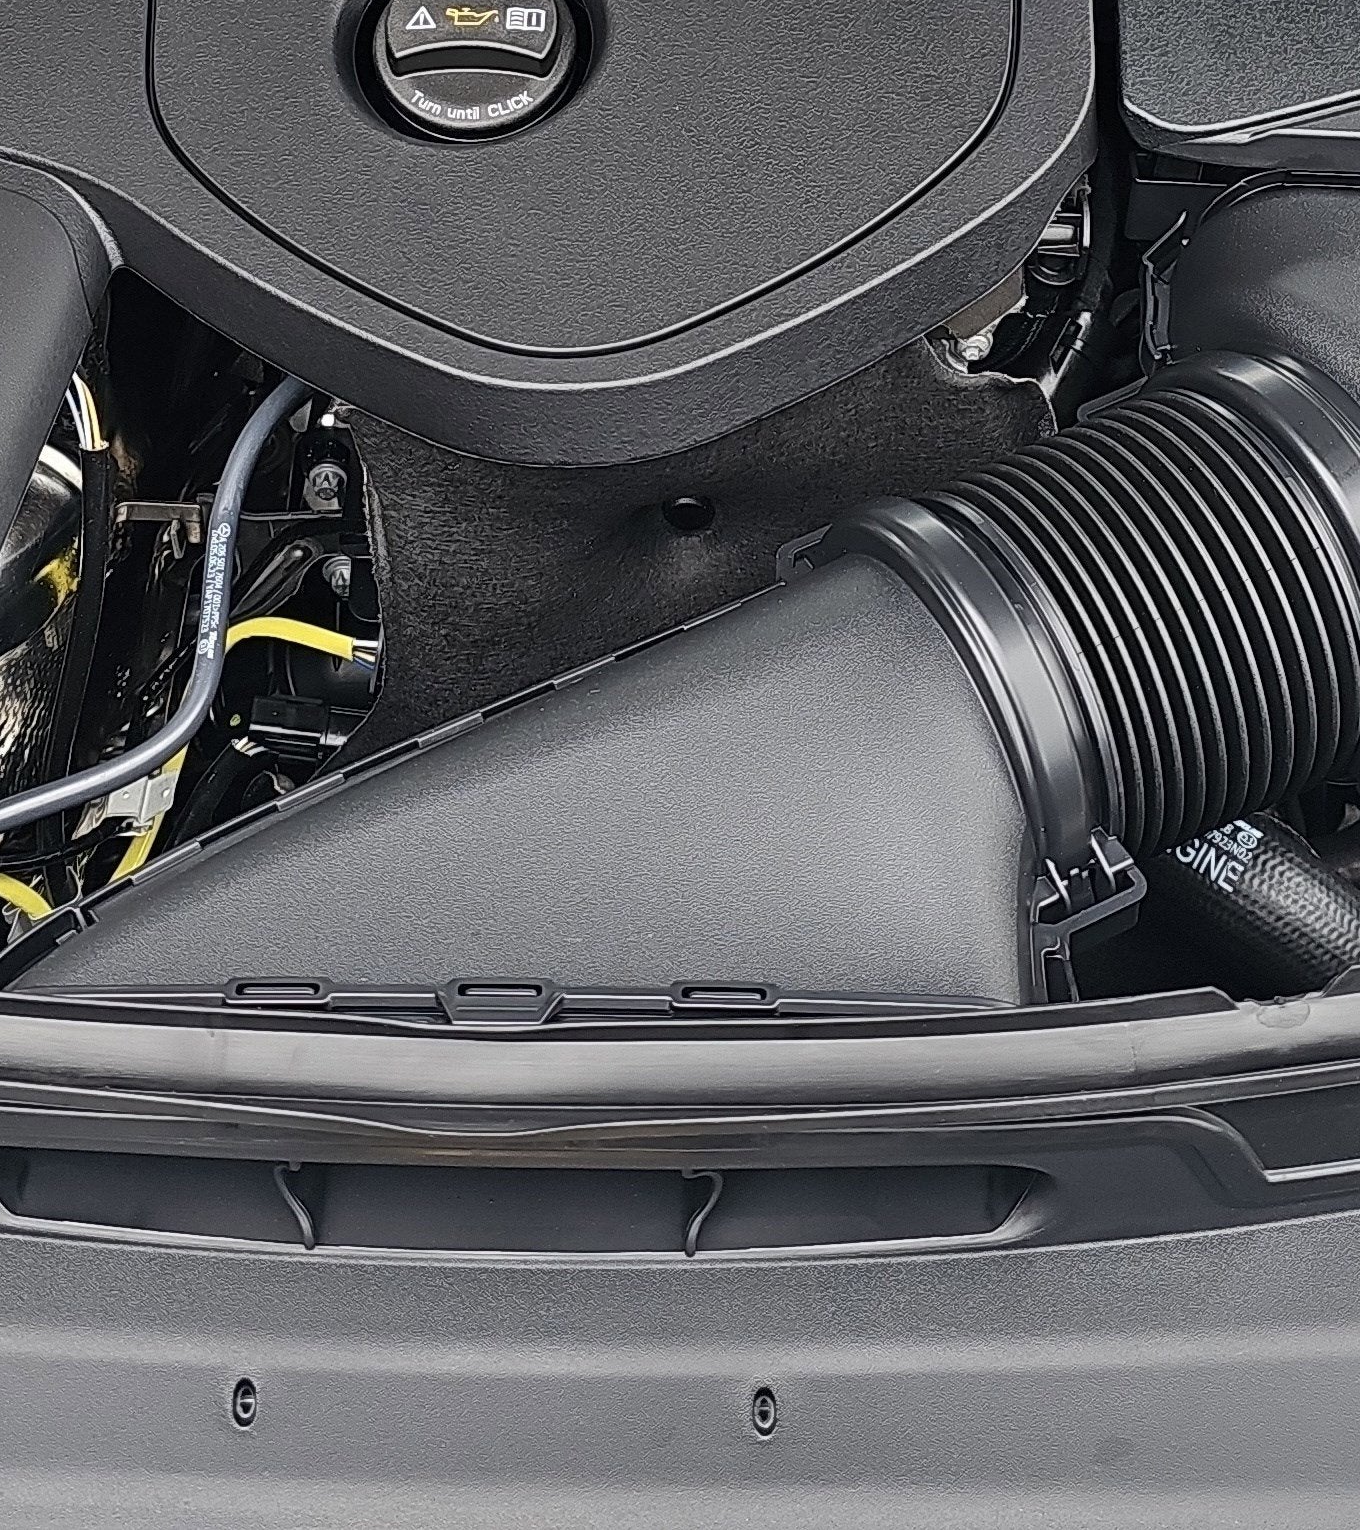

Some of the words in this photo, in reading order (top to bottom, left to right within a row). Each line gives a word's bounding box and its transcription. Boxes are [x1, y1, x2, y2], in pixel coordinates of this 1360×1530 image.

[410, 90, 442, 117] Turn
[447, 106, 480, 120] until
[487, 90, 534, 117] CLICK
[1166, 838, 1245, 893] GINE
